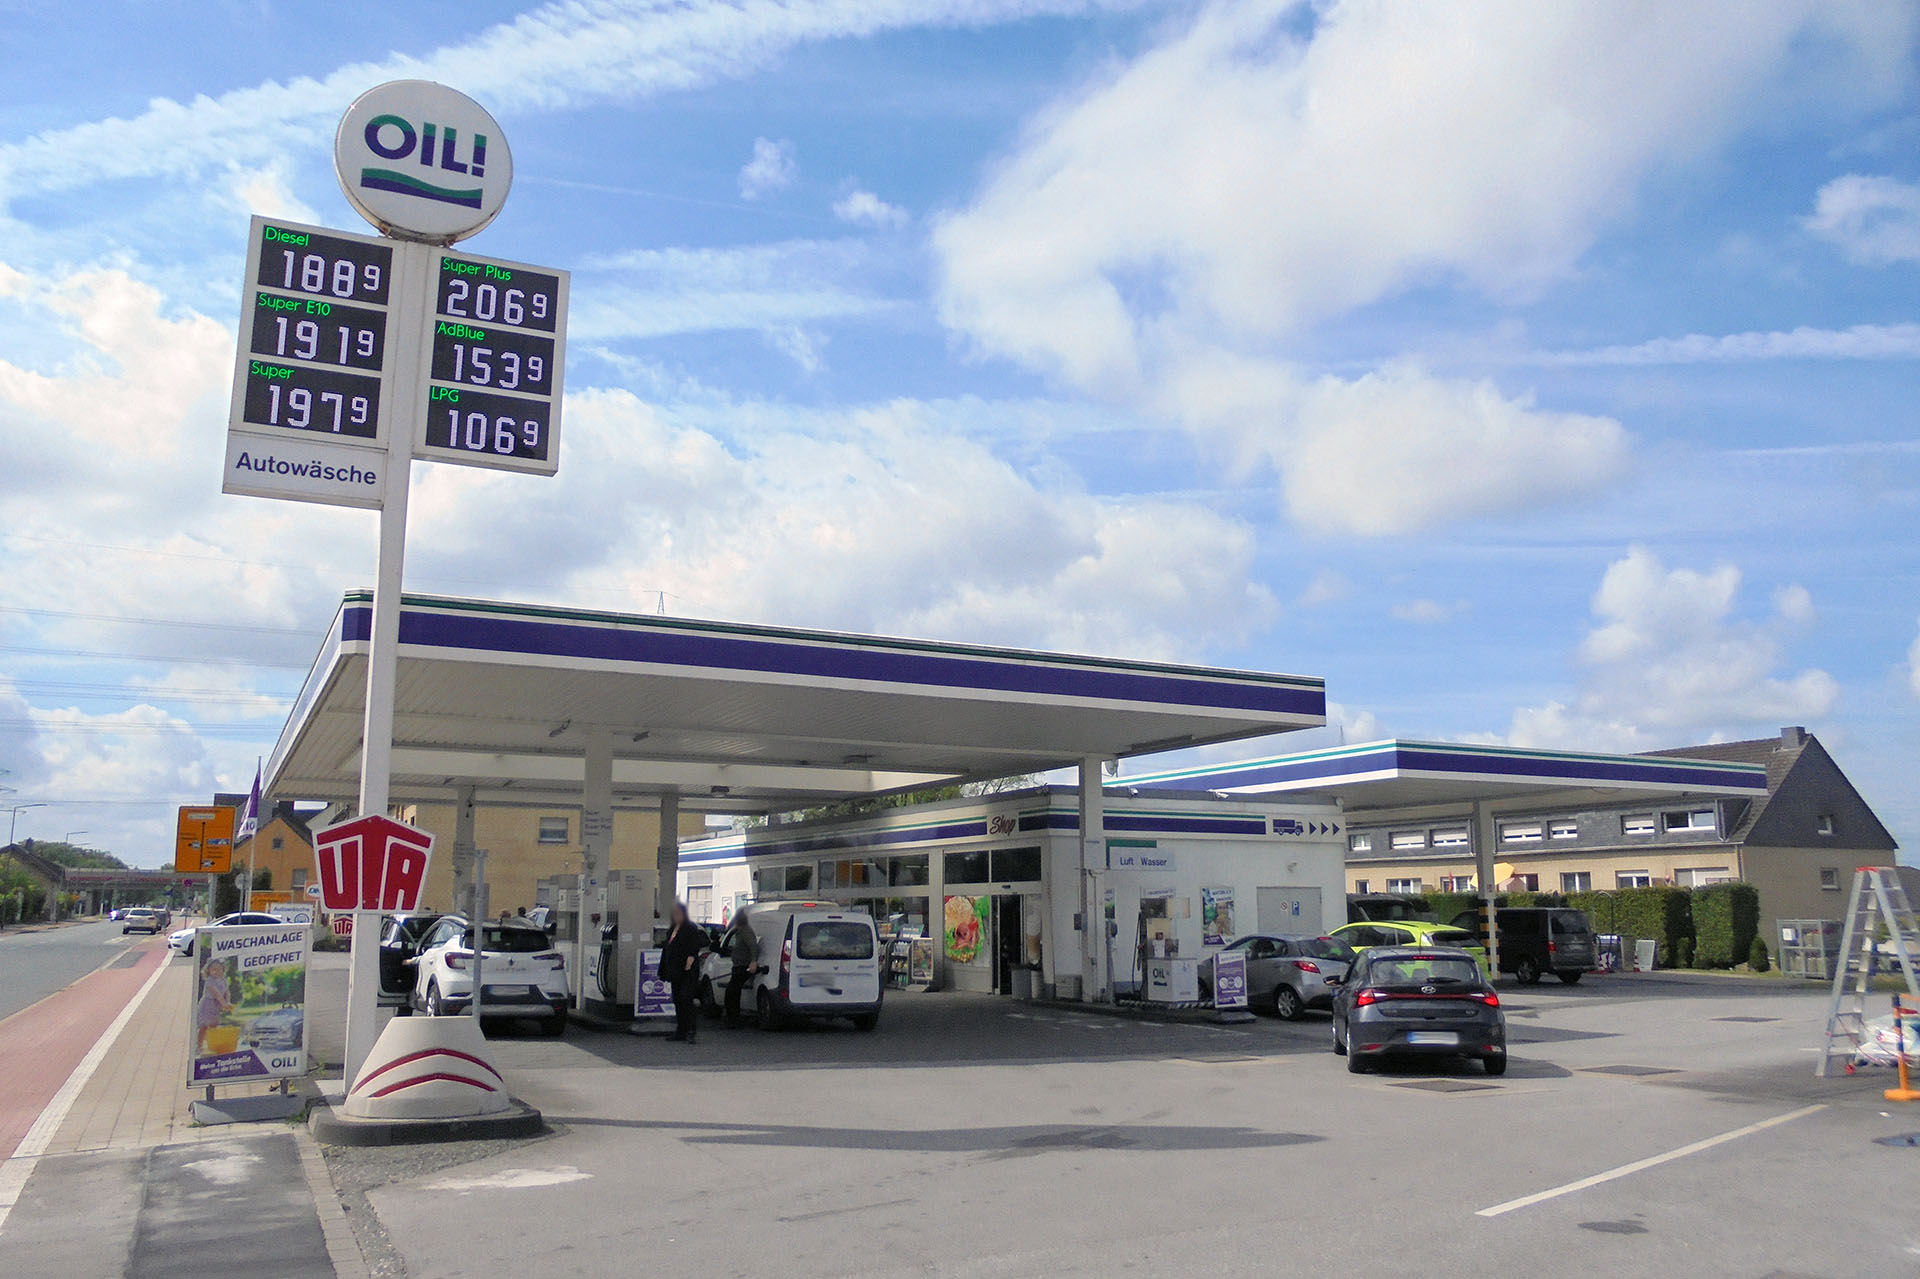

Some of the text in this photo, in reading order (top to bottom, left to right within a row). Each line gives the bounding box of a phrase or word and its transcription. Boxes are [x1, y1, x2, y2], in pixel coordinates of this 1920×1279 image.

[364, 114, 487, 178] OIL!
[265, 227, 309, 247] Diesel
[282, 249, 381, 298] 1889
[443, 257, 511, 282] Super Plus
[258, 292, 331, 316] Super E10
[447, 279, 548, 325] 2069
[437, 321, 485, 342] AdBlue
[251, 360, 295, 381] Super
[453, 344, 543, 389] 1539
[431, 386, 459, 403] LPG
[269, 384, 368, 432] 1979
[448, 409, 539, 454] 1069
[235, 452, 377, 486] Autowäsche
[989, 814, 1017, 836] Shop
[316, 815, 433, 910] UTA
[1119, 856, 1168, 866] Luft Wasser
[216, 931, 303, 952] WASCHANLAGE
